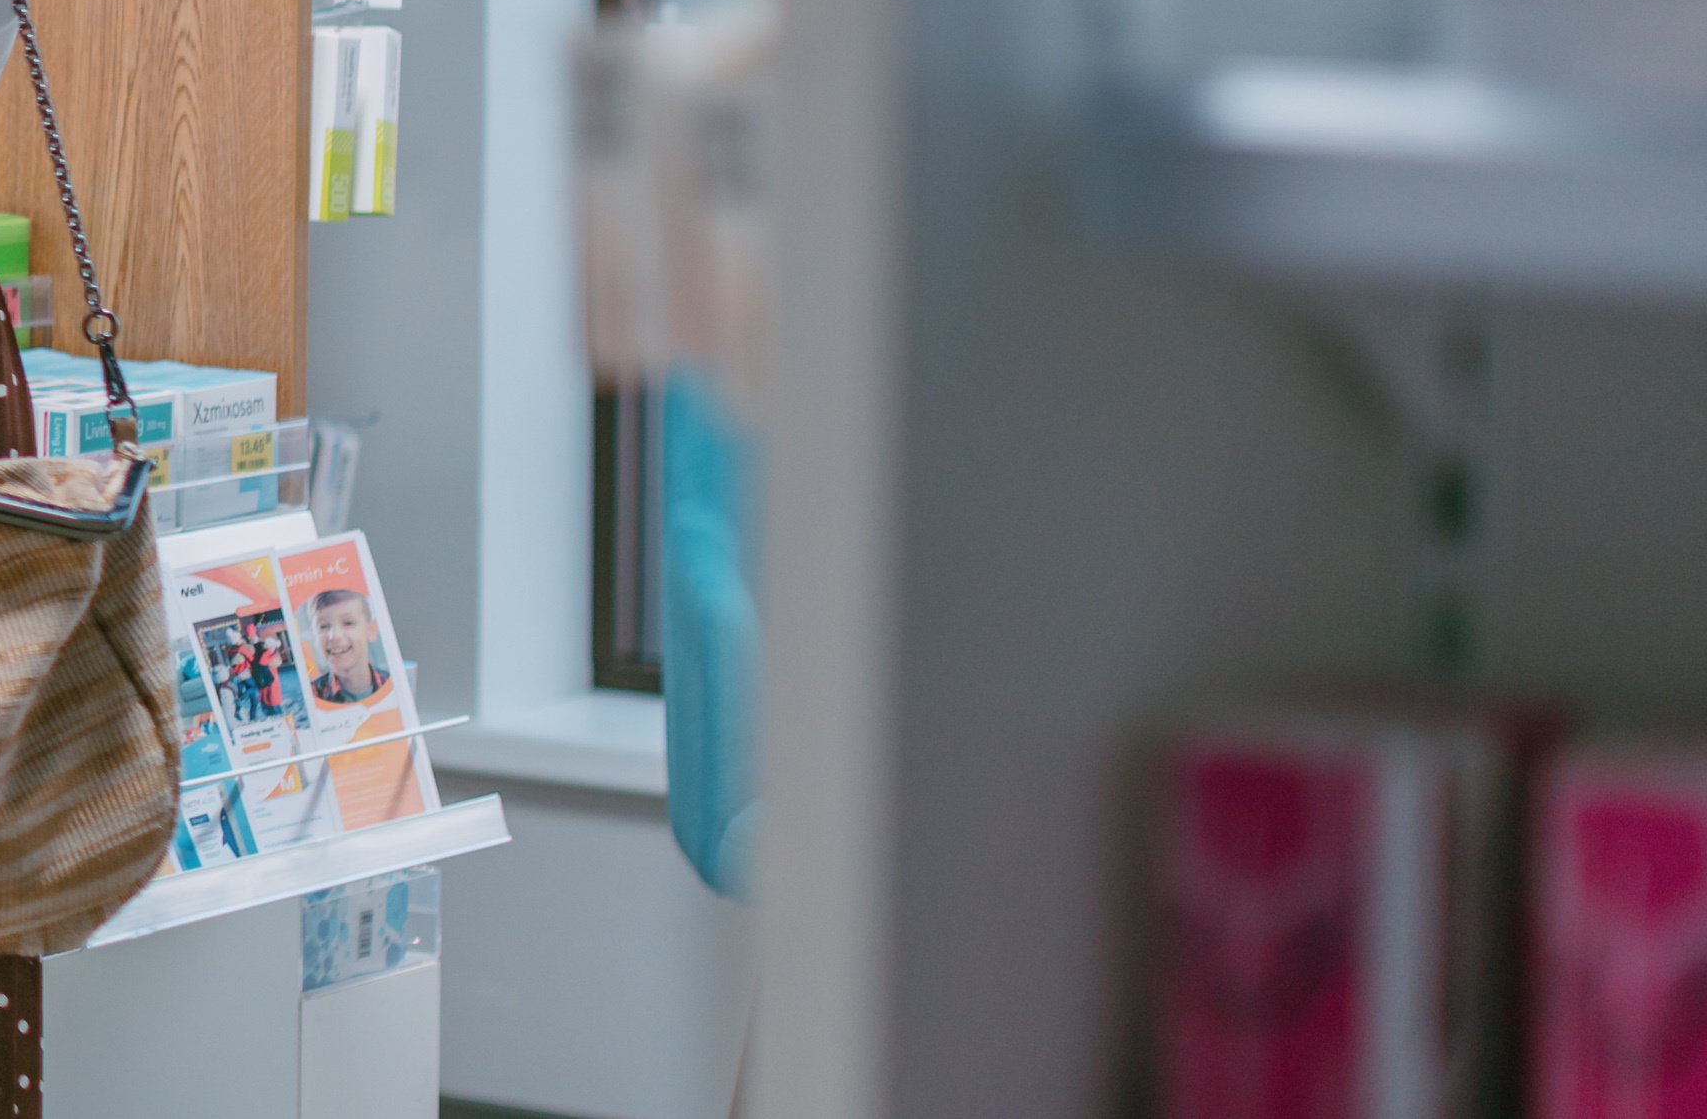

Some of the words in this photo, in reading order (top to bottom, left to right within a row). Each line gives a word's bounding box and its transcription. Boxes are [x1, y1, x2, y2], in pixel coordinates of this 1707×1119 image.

[193, 396, 264, 424] Xzmixosam
[85, 421, 112, 441] Livin
[284, 566, 323, 588] amin
